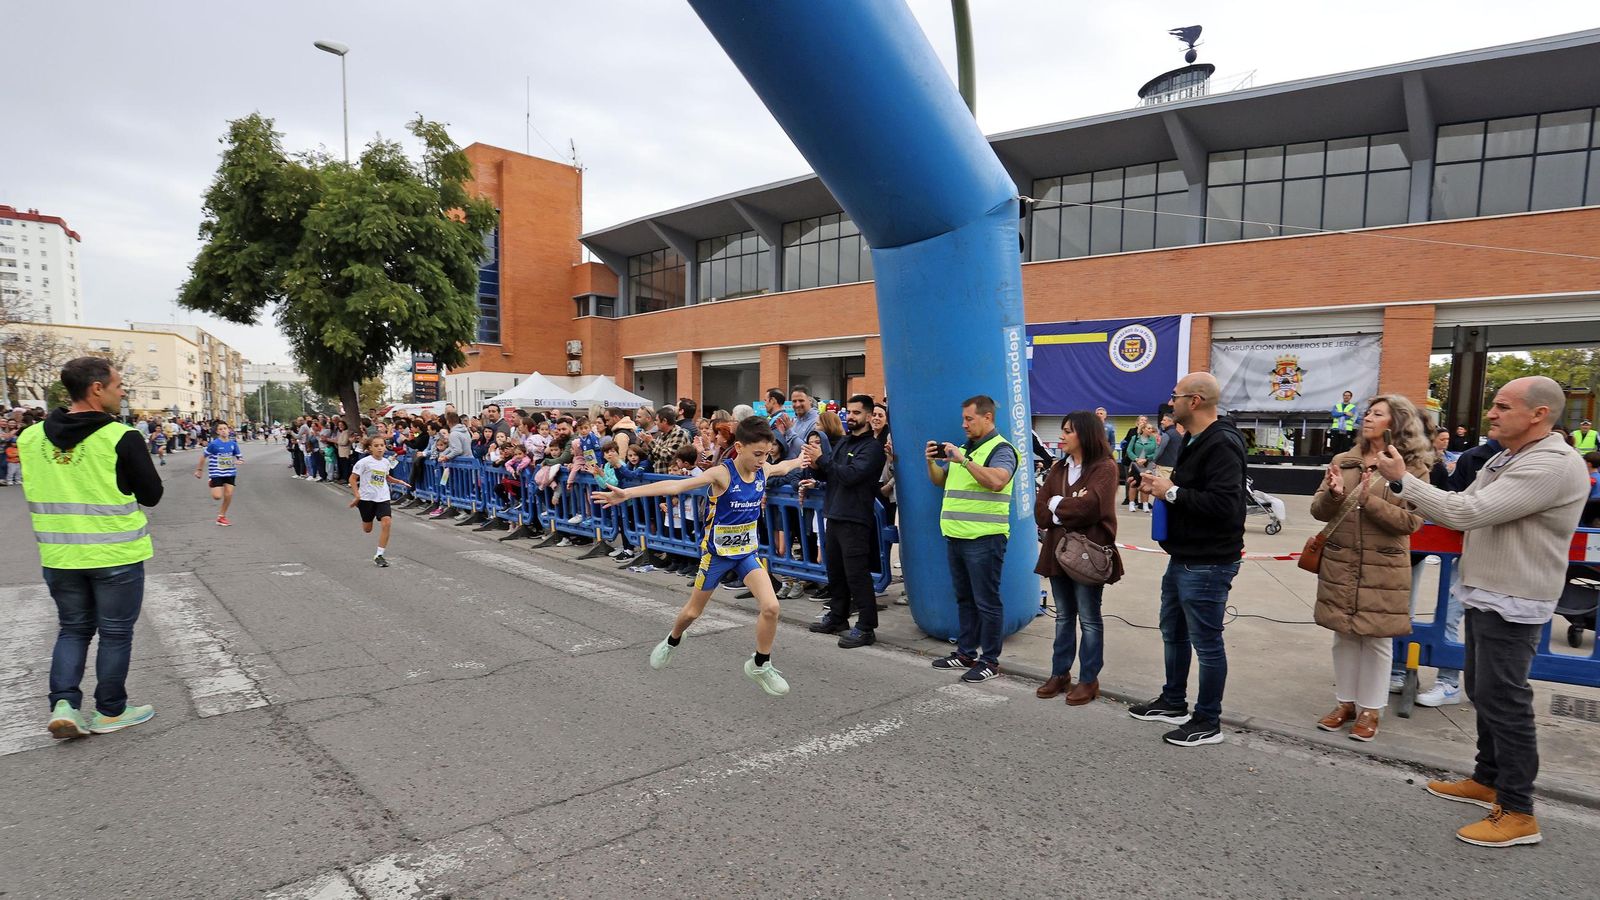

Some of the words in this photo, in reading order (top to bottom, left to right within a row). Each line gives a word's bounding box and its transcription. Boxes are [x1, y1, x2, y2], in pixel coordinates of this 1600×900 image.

[1334, 340, 1360, 348] JEREZ
[1008, 331, 1030, 512] deportes@aytojerez.es
[721, 532, 751, 546] 224
